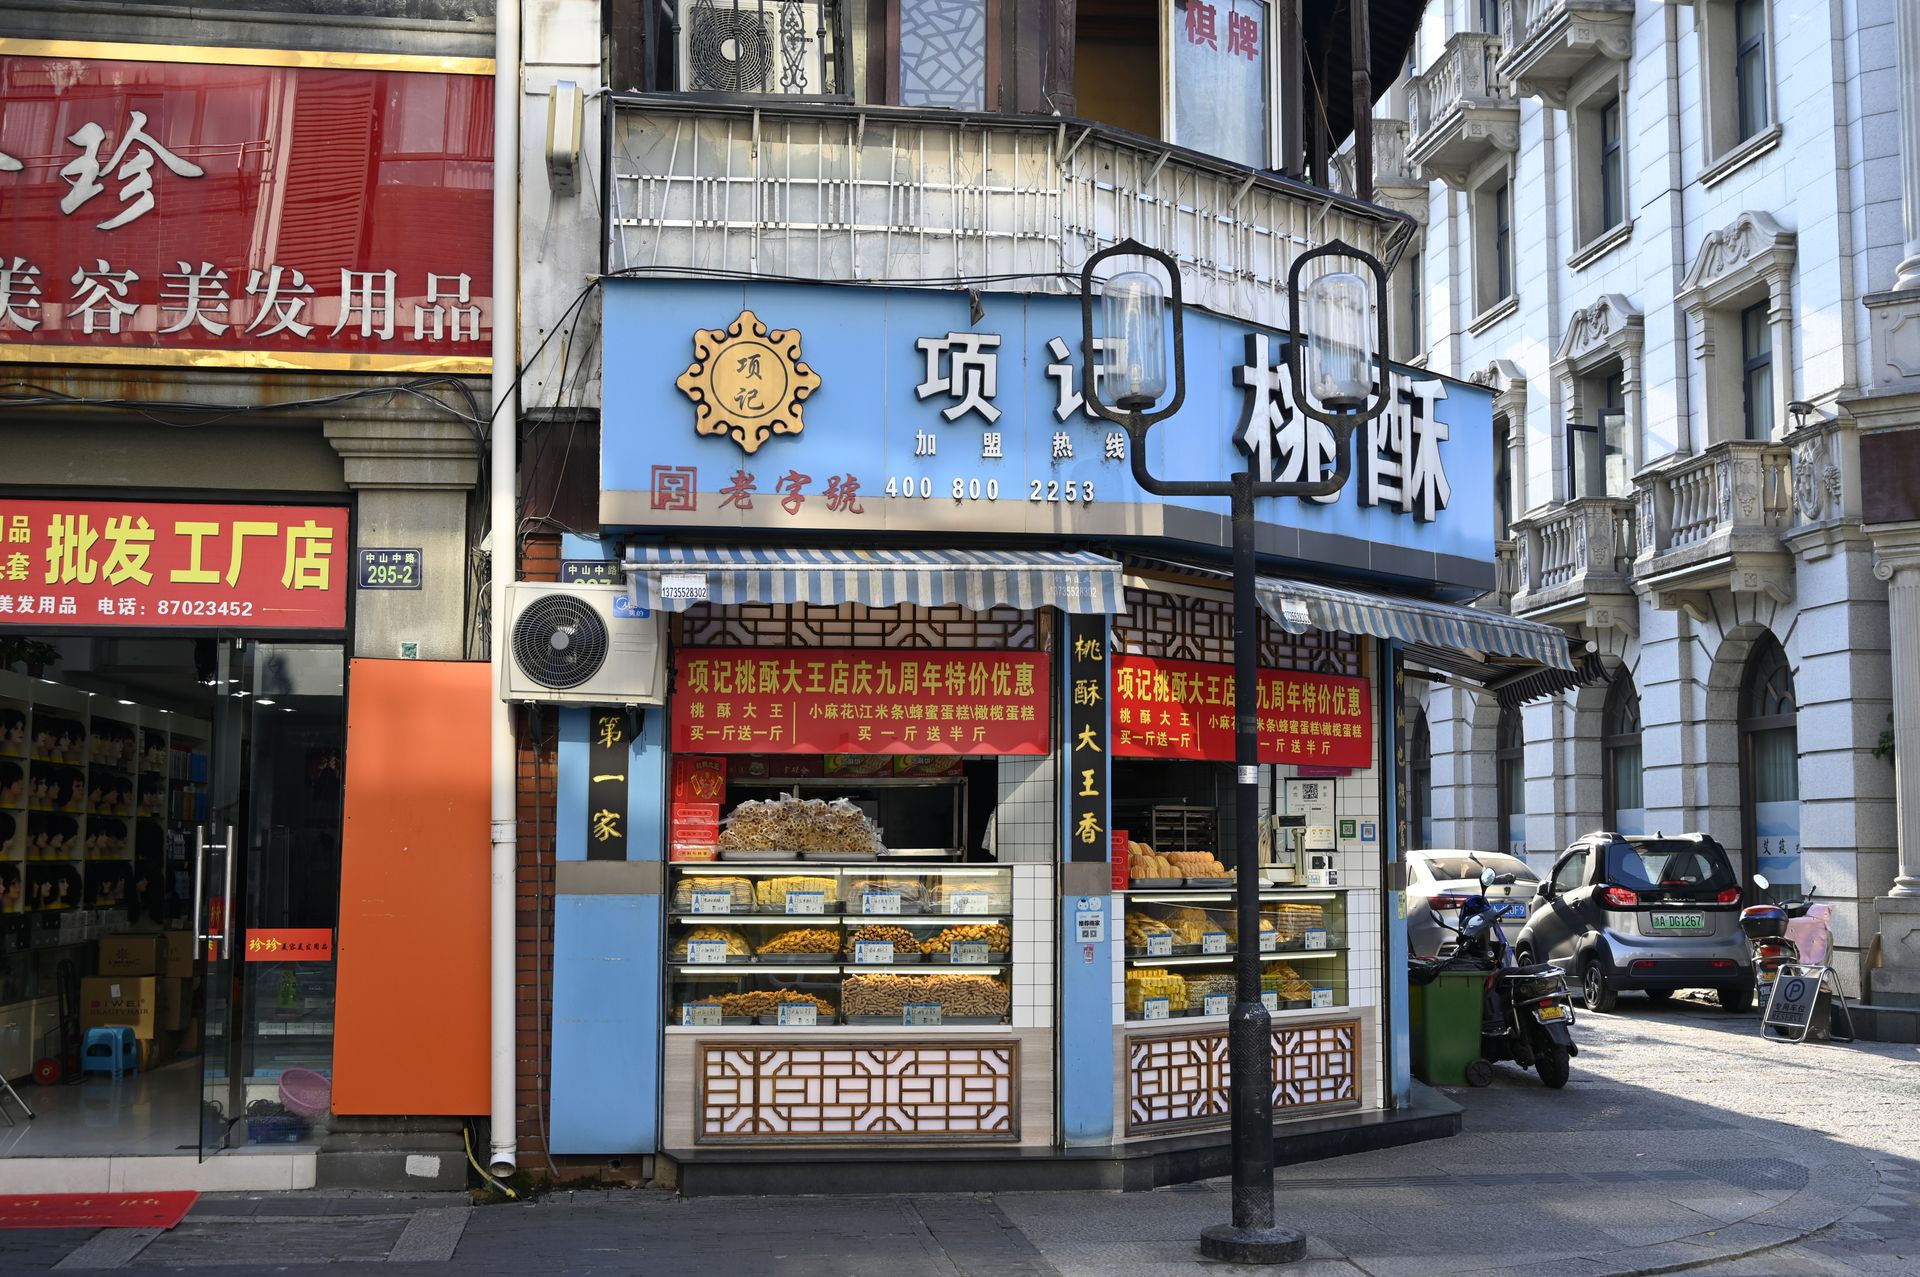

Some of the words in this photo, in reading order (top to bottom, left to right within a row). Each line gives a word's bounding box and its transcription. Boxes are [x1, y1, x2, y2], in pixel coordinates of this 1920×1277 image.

[1185, 0, 1259, 61] 棋牌
[0, 257, 481, 341] 美容美发用品
[733, 353, 765, 411] 项记
[915, 430, 1126, 460] 加盟热线
[718, 469, 865, 516] 老字號
[885, 476, 932, 499] 400
[952, 478, 999, 501] 800
[1030, 479, 1095, 502] 2253
[0, 515, 31, 543] 品
[45, 514, 155, 586] 批发
[170, 520, 334, 590] 工厂店
[366, 553, 415, 564] 中山中路
[368, 565, 412, 584] 295-2
[568, 564, 617, 576] 中山中路
[662, 587, 707, 598] 13735528302
[157, 600, 253, 617] 87023452
[688, 659, 1035, 696] 项记桃酥大王店庆九周年特价优惠
[1117, 667, 1361, 717] 项记桃酥大王店九周年特价优惠
[690, 702, 783, 719] 桃酥大王
[1120, 708, 1190, 727] 桃酥大王
[690, 725, 783, 741] 买一斤送一斤
[857, 725, 986, 742] 买一斤送半斤
[1074, 633, 1104, 844] 桃酥大王香
[1120, 729, 1191, 748] 买一斤送一斤
[1260, 738, 1331, 755] 一斤送半斤
[592, 716, 625, 842] 第一家
[249, 937, 282, 953] 珍珍
